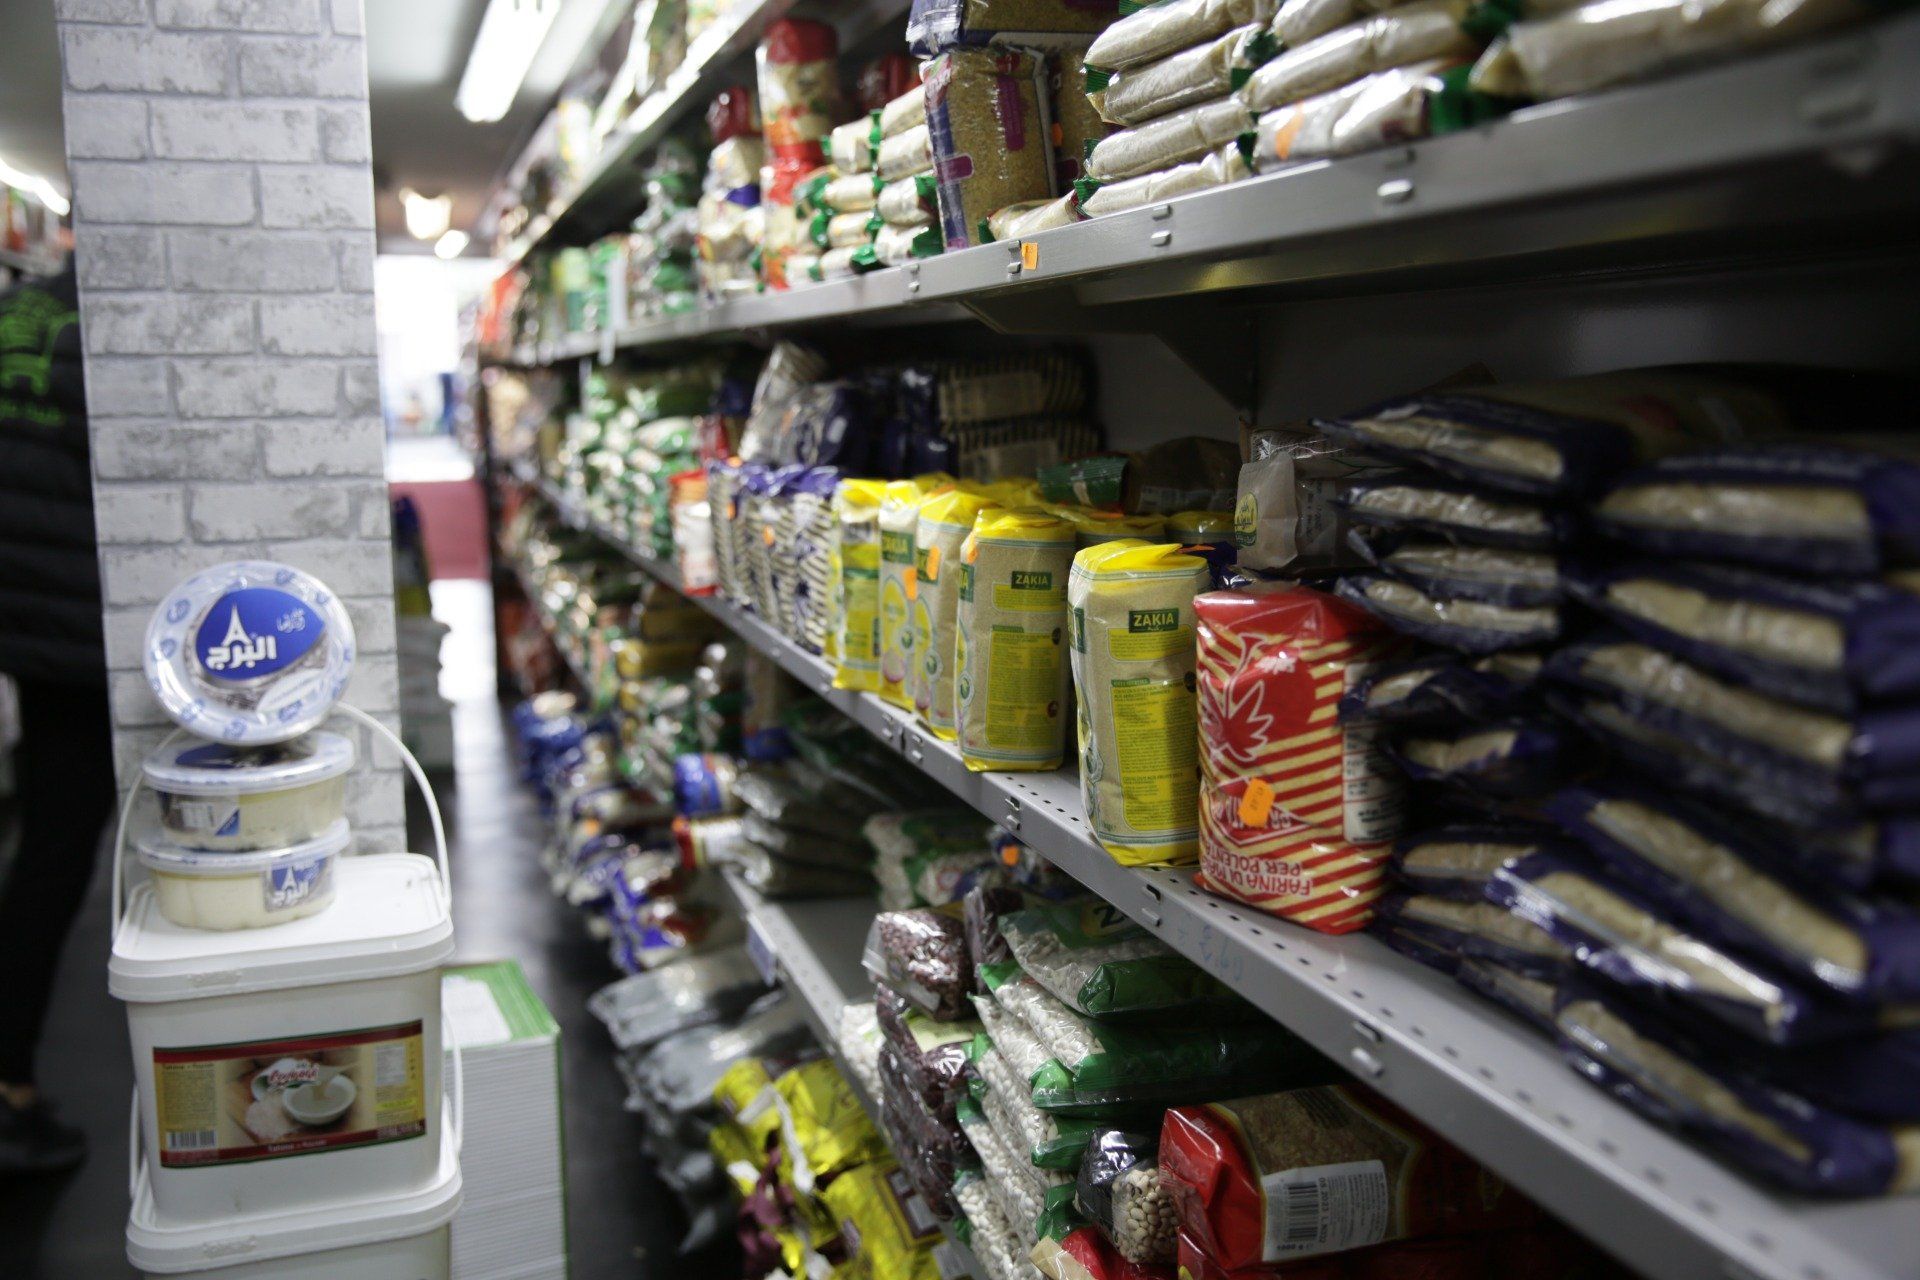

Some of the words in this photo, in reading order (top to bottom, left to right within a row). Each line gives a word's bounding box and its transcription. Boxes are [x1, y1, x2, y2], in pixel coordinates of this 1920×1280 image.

[1015, 575, 1048, 585] ZAKIA
[1133, 613, 1175, 627] ZAKIA
[1265, 861, 1302, 877] PER
[1246, 874, 1312, 897] FARINA
